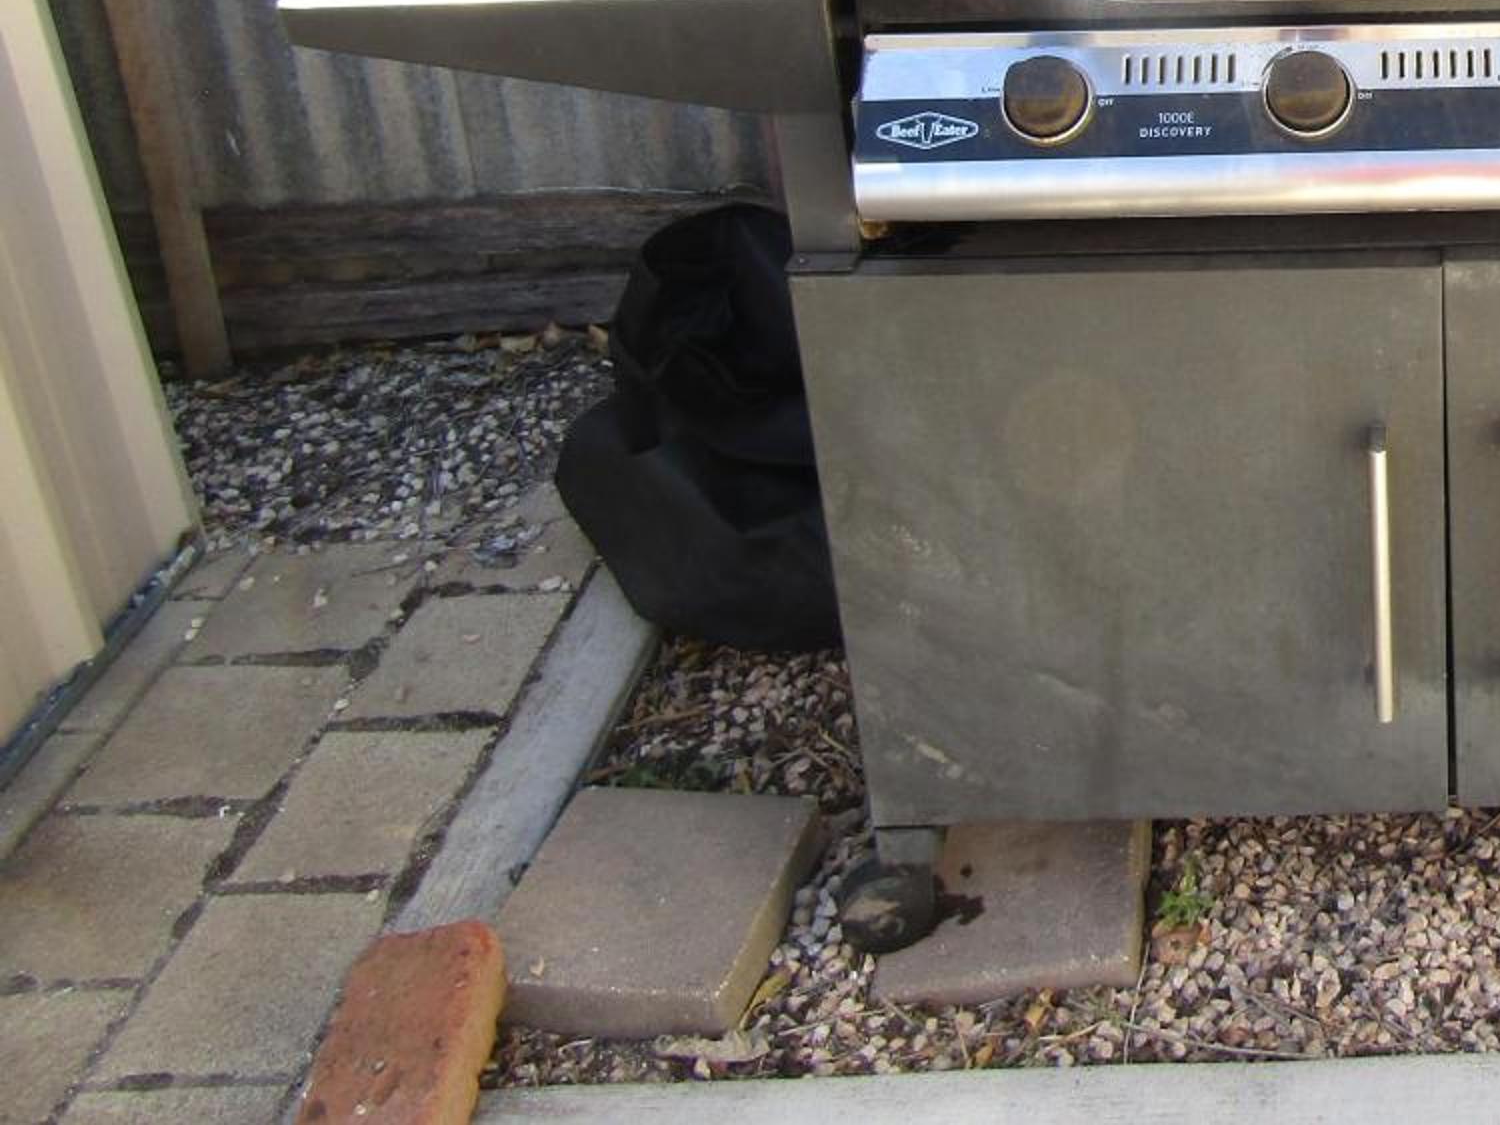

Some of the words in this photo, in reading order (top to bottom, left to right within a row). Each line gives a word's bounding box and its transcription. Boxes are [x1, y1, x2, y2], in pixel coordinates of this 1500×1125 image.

[891, 125, 922, 137] Beef
[934, 123, 969, 136] Eater
[1139, 125, 1212, 138] DISCOVERY
